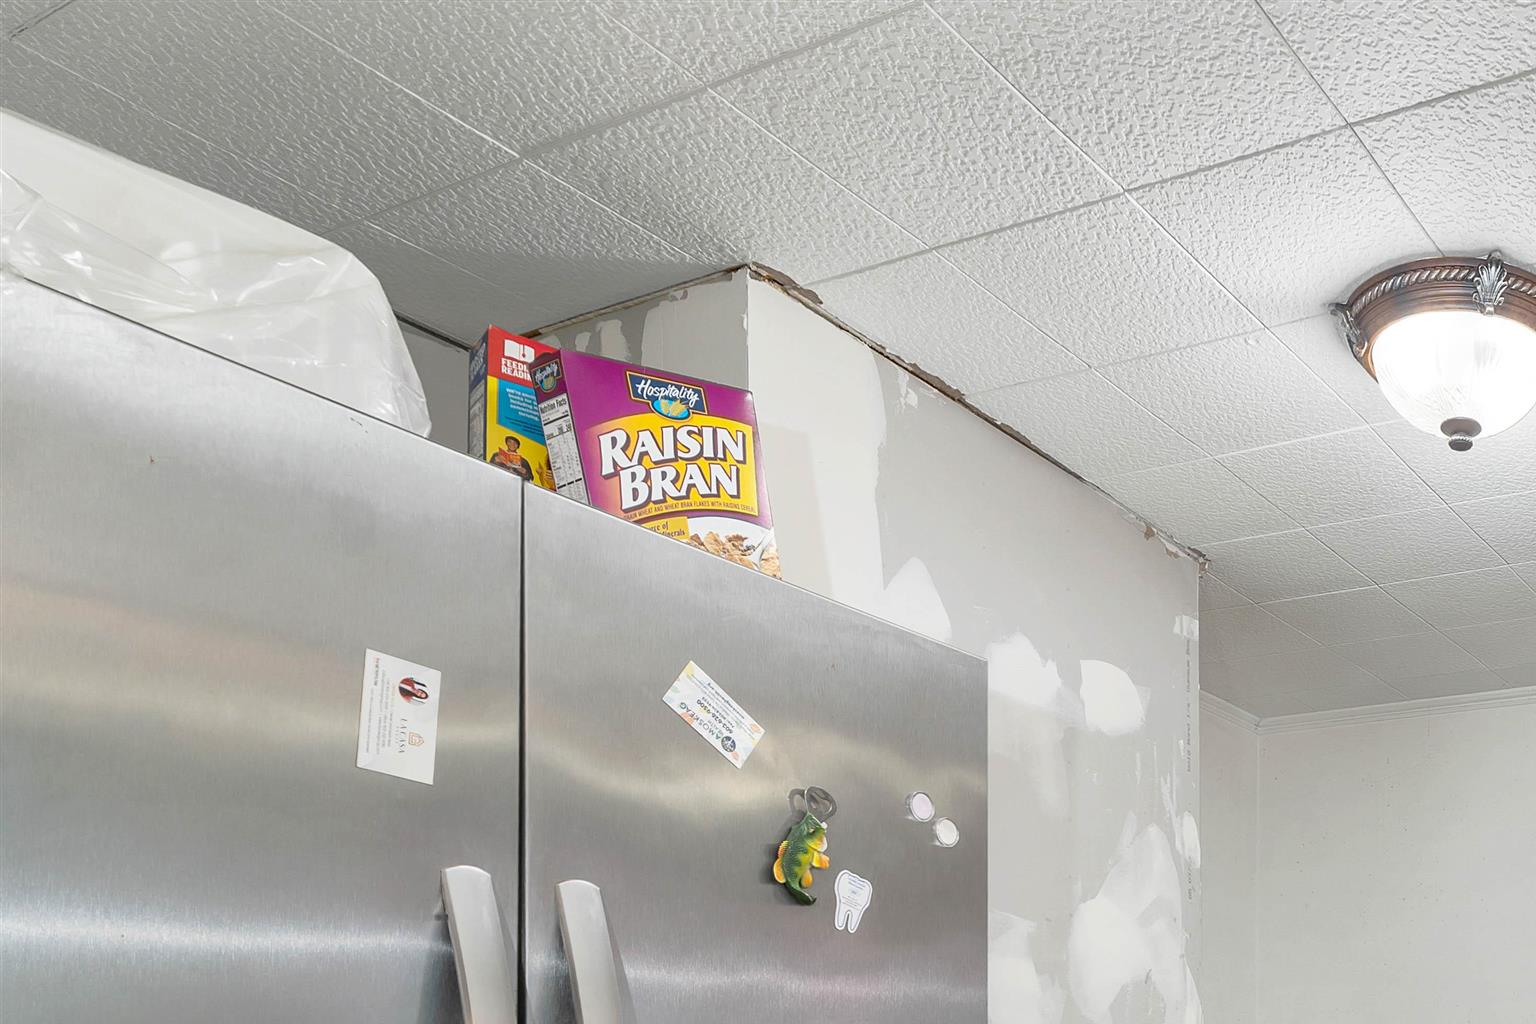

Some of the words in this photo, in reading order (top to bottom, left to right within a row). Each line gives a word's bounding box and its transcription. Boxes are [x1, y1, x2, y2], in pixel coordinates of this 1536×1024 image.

[635, 378, 700, 403] Hospitality
[598, 425, 746, 478] RAISIN
[619, 464, 739, 513] BRAN
